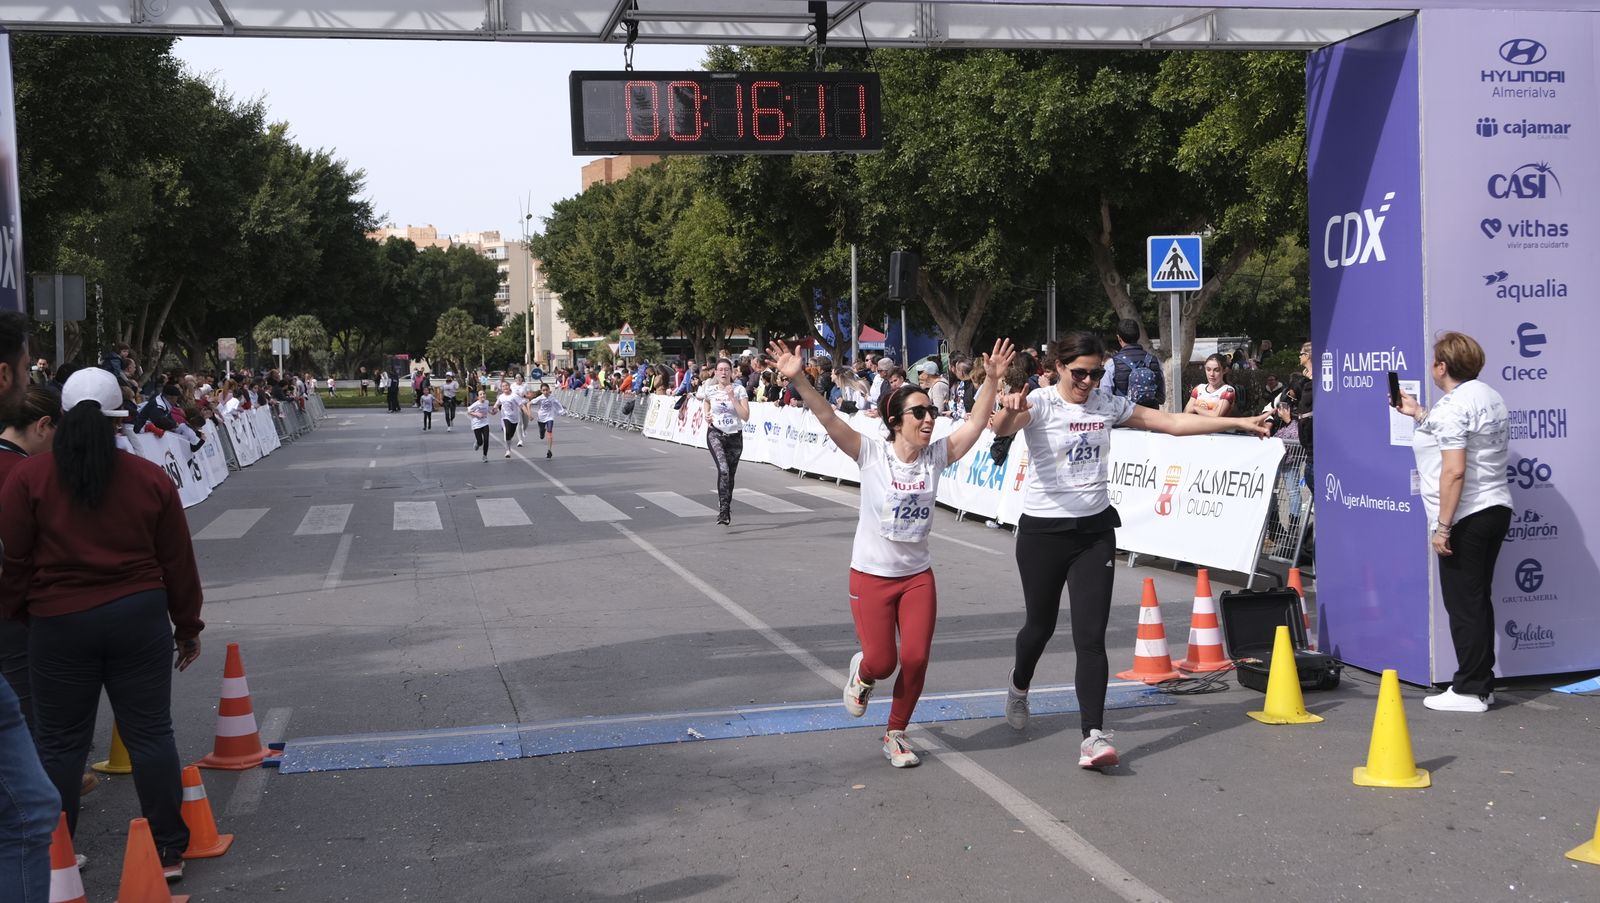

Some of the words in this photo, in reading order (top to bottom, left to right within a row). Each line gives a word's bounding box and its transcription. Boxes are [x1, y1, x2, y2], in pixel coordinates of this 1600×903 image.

[1481, 70, 1565, 83] HYUNDAI
[1503, 119, 1571, 138] cajamar
[1488, 173, 1546, 199] CASI
[1508, 220, 1568, 237] vithas
[1496, 279, 1568, 303] aqualia
[1343, 346, 1407, 371] ALMERÍA
[1343, 375, 1373, 388] CIUDAD
[1502, 366, 1548, 380] Clece
[1070, 422, 1105, 432] MUJER
[1529, 408, 1567, 439] CASH
[1066, 445, 1101, 462] 1231
[1106, 459, 1157, 490] MERÍA
[1189, 466, 1264, 499] ALMERÍA
[892, 505, 930, 519] 1249
[1187, 499, 1224, 517] CIUDAD
